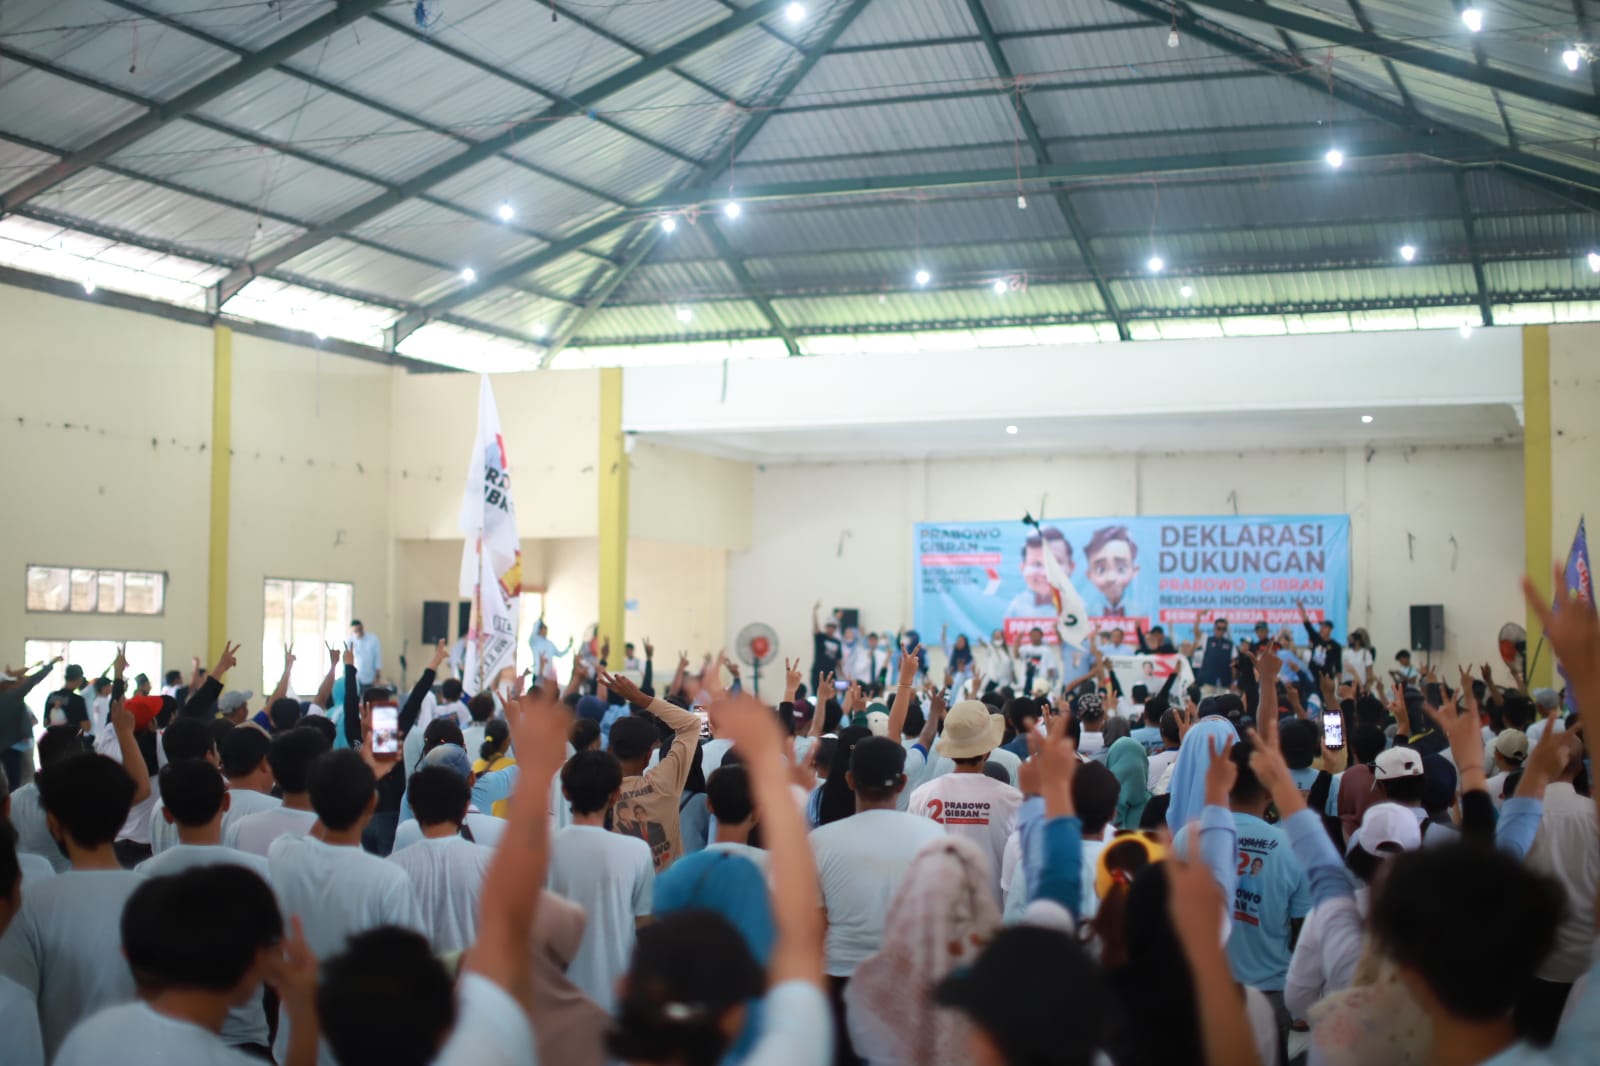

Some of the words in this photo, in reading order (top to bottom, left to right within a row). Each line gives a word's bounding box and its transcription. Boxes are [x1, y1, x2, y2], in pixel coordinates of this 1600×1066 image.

[1161, 525, 1324, 547] DEKLARASI
[1159, 551, 1325, 573] DUKUNGAN
[1159, 578, 1246, 592] PRABOWO
[1261, 578, 1324, 592] GIBRAN
[1159, 595, 1216, 606] BERSAMA
[1220, 595, 1285, 606] INDONESIA
[927, 799, 945, 824] 2
[944, 801, 990, 810] PRABOWO
[944, 809, 979, 817] GIBRAN
[1236, 851, 1250, 876] 2
[1235, 888, 1262, 904] OWO
[1234, 899, 1248, 912] AN
